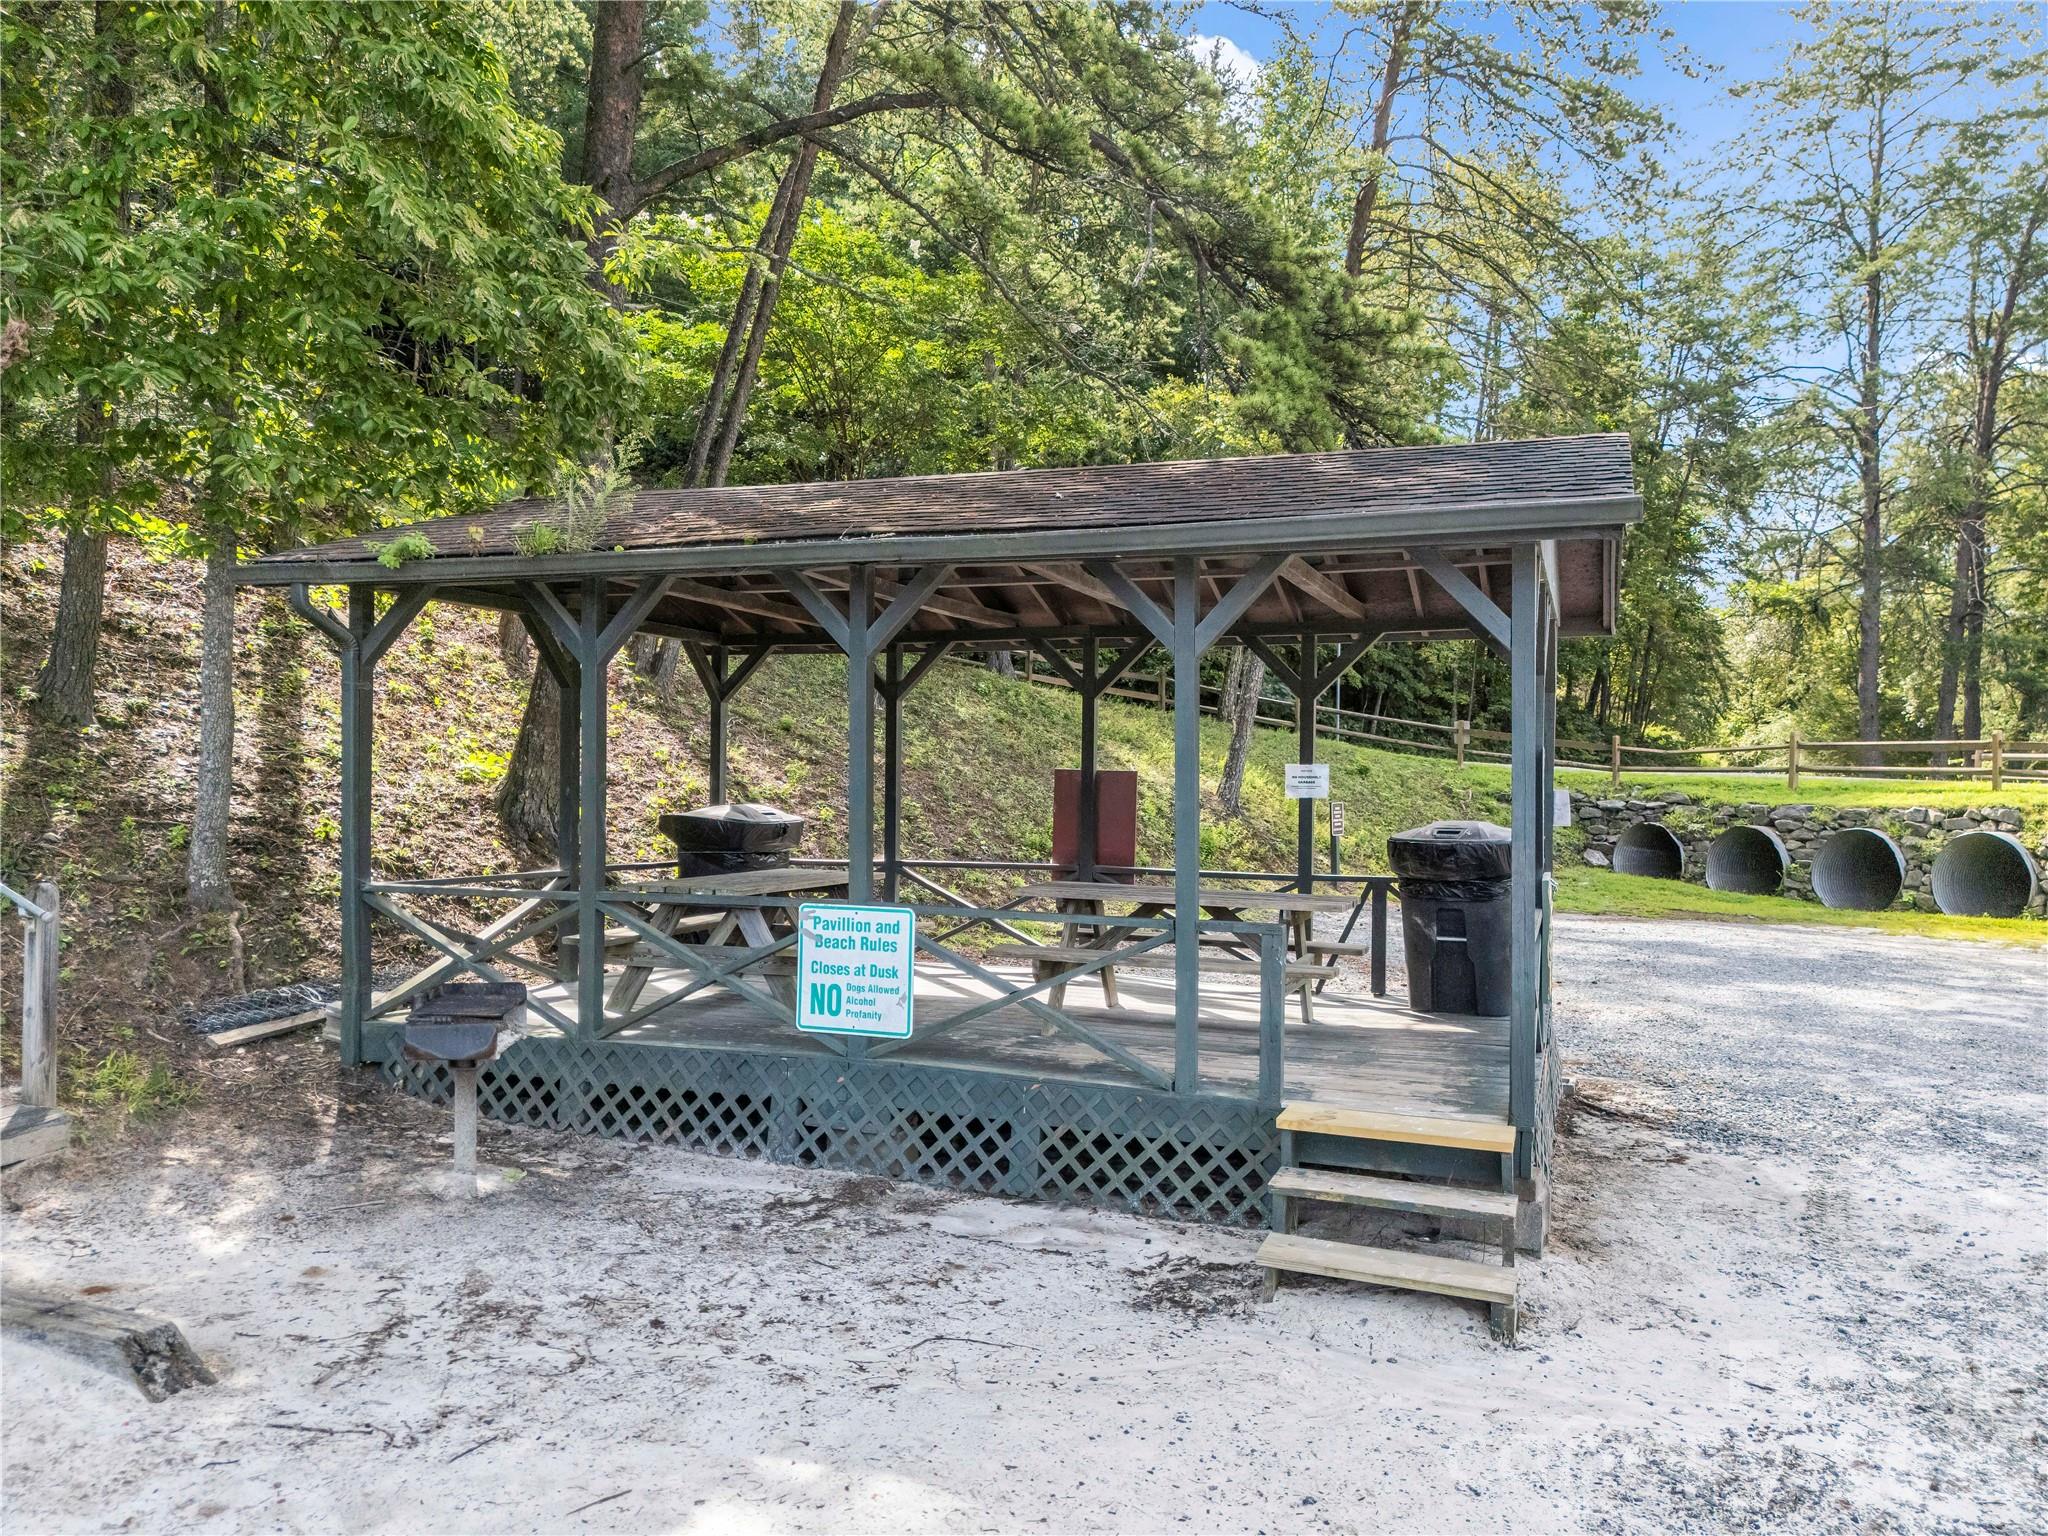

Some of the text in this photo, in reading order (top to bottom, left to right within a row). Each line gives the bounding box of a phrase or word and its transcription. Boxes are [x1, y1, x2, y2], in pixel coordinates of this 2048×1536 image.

[813, 916, 900, 934] Pavillion and
[815, 934, 898, 953] Beach Rules
[811, 960, 899, 979] Closes at Dusk
[846, 983, 900, 995] Dogs Allowed
[810, 983, 842, 1017] NO
[846, 996, 876, 1006] Alcohol
[845, 1009, 882, 1022] Profanity
